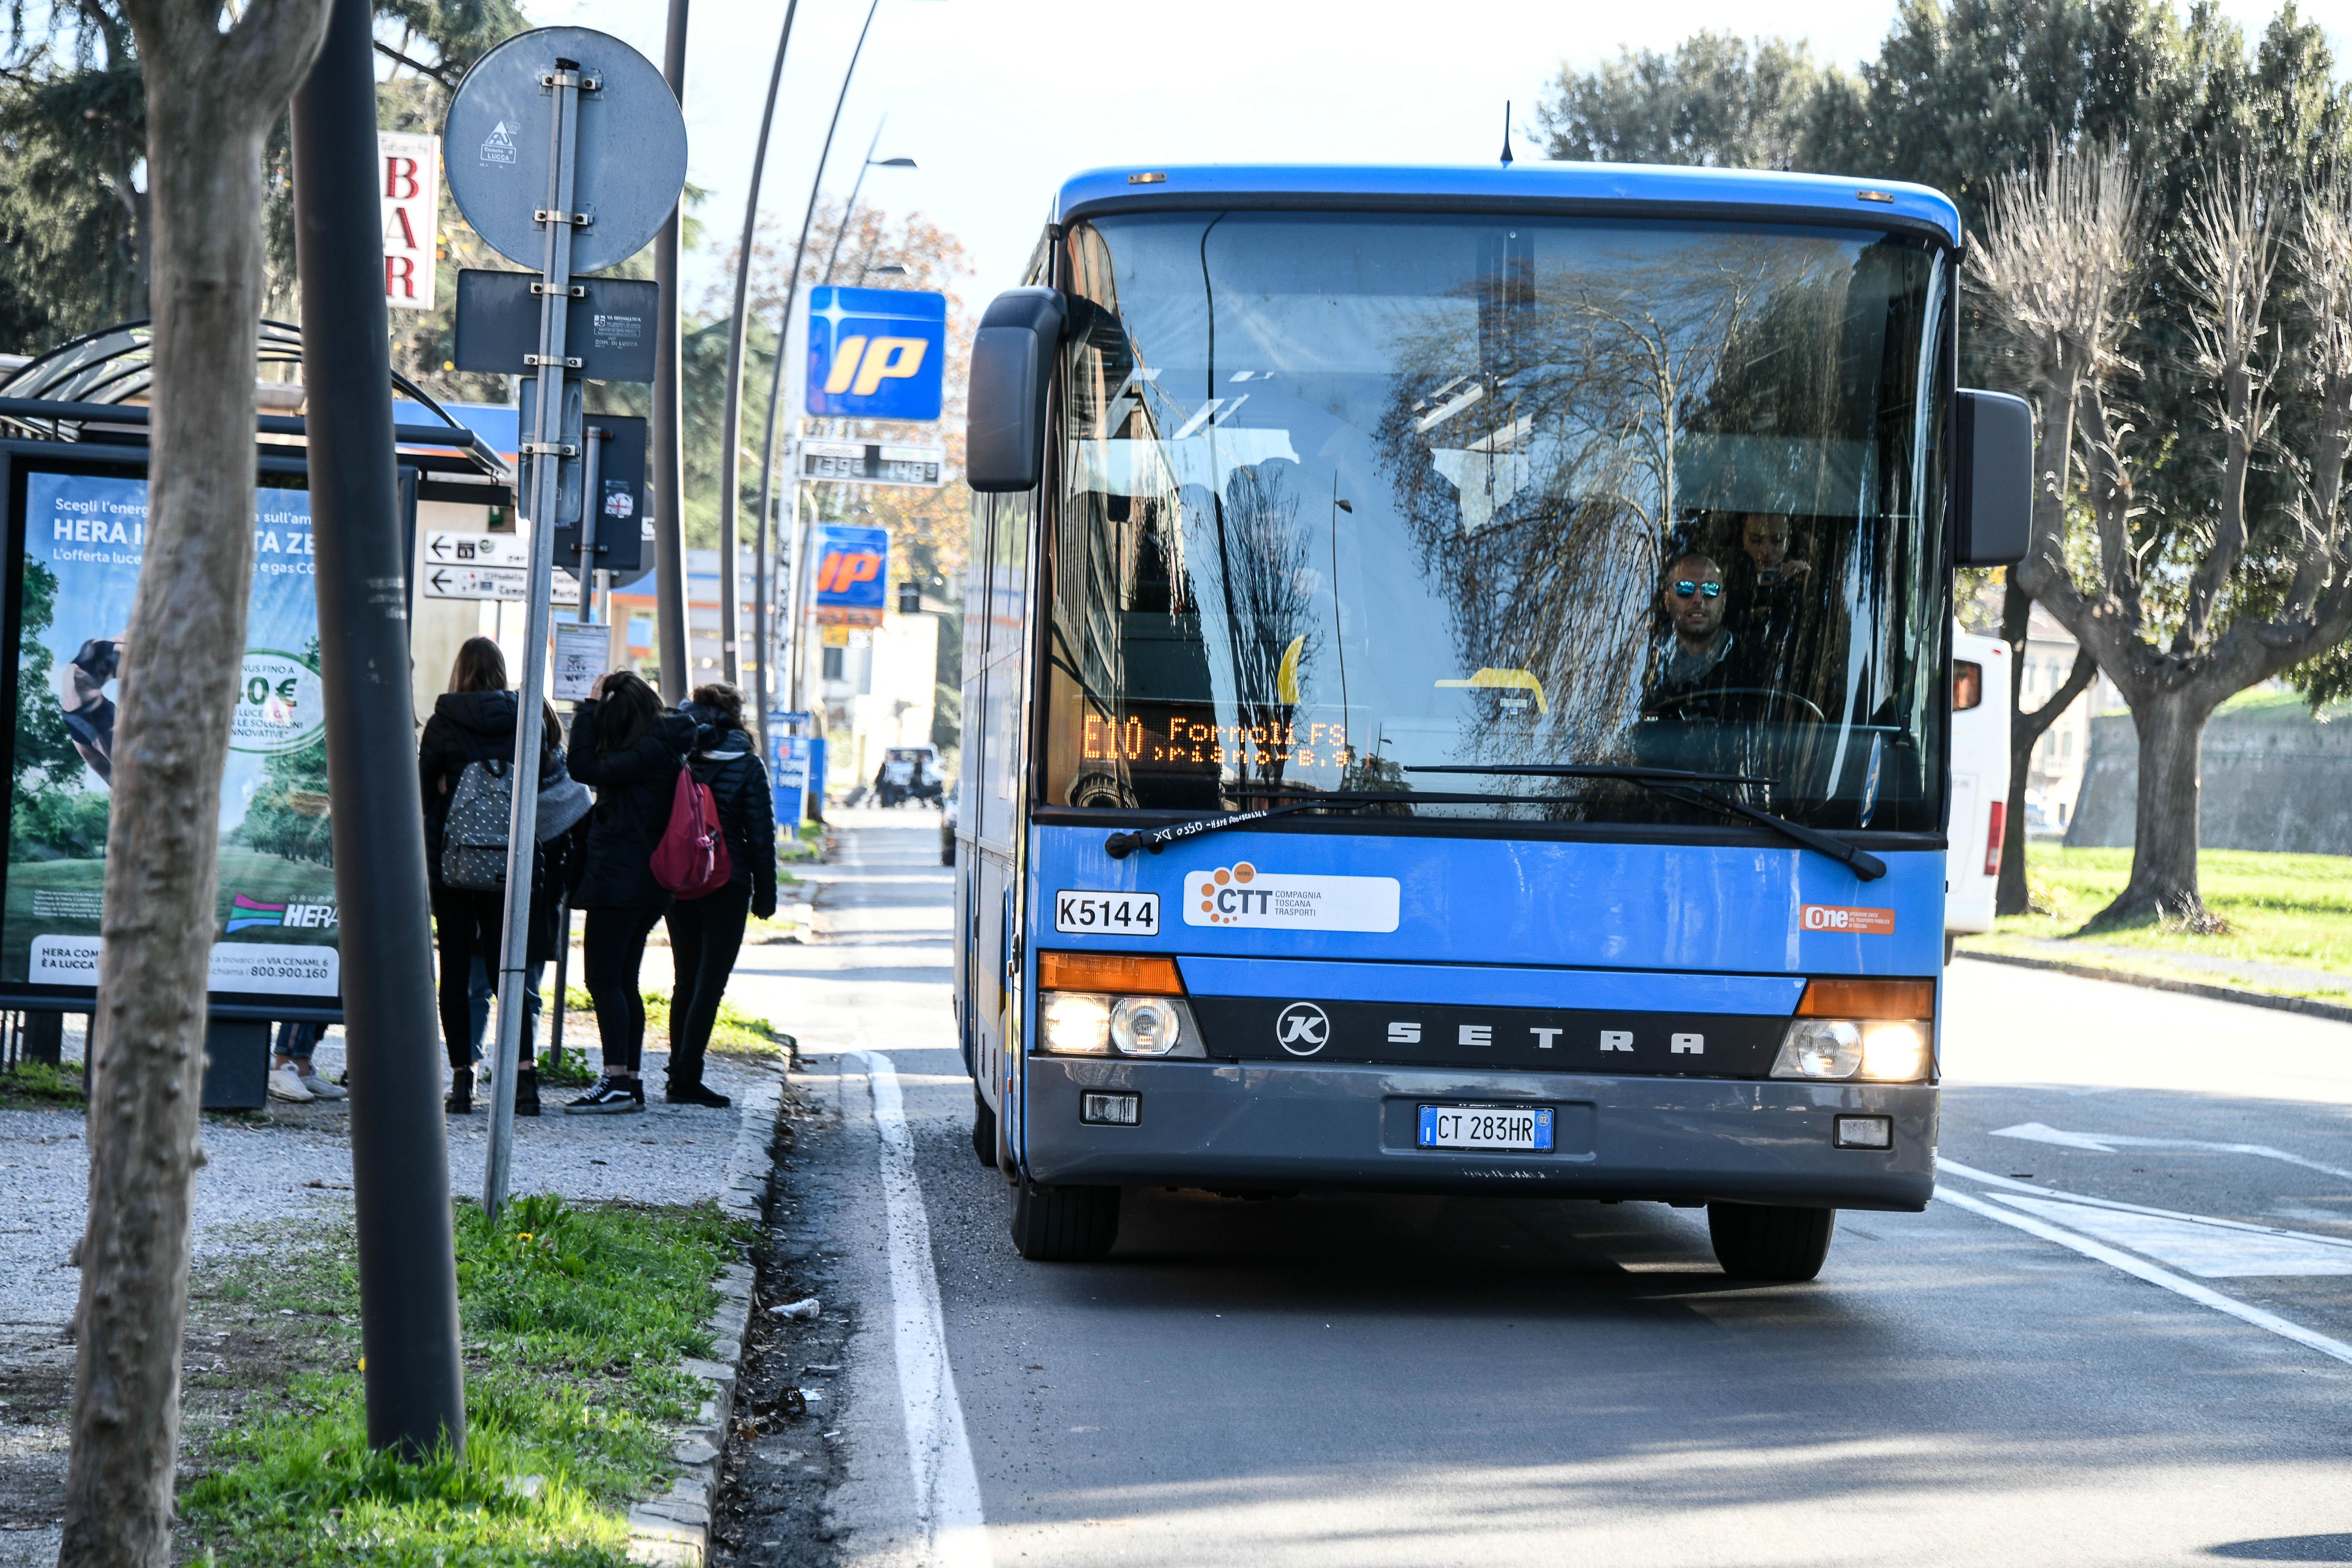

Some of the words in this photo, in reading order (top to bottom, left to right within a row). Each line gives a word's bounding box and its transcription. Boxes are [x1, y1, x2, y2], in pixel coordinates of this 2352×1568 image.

[487, 153, 509, 161] LUCCA
[383, 156, 419, 300] BAR
[823, 335, 929, 396] IP
[55, 498, 97, 514] Scegli
[54, 518, 128, 544] HERA
[53, 548, 110, 563] L'offerta
[112, 552, 141, 565] luce
[271, 563, 294, 575] gas
[817, 552, 882, 593] IP
[263, 665, 285, 674] FINO
[275, 678, 297, 707] €
[1084, 714, 1142, 760] E10
[1170, 717, 1297, 745] Fornoli
[1310, 722, 1346, 747] FS
[1060, 899, 1153, 927] K5144
[1217, 888, 1272, 914] CTT
[1275, 890, 1321, 899] COMPAGNIA
[1275, 899, 1311, 907] TOSCANA
[1275, 908, 1315, 916] TRASPORTI
[283, 904, 338, 928] HERA
[41, 958, 47, 967] È
[59, 960, 95, 969] LUCCA
[42, 948, 71, 957] HERA
[251, 966, 327, 978] 800.900.160
[1388, 1022, 1704, 1054] SETRA
[1438, 1115, 1462, 1139] CT
[1470, 1116, 1533, 1141] 283HR
